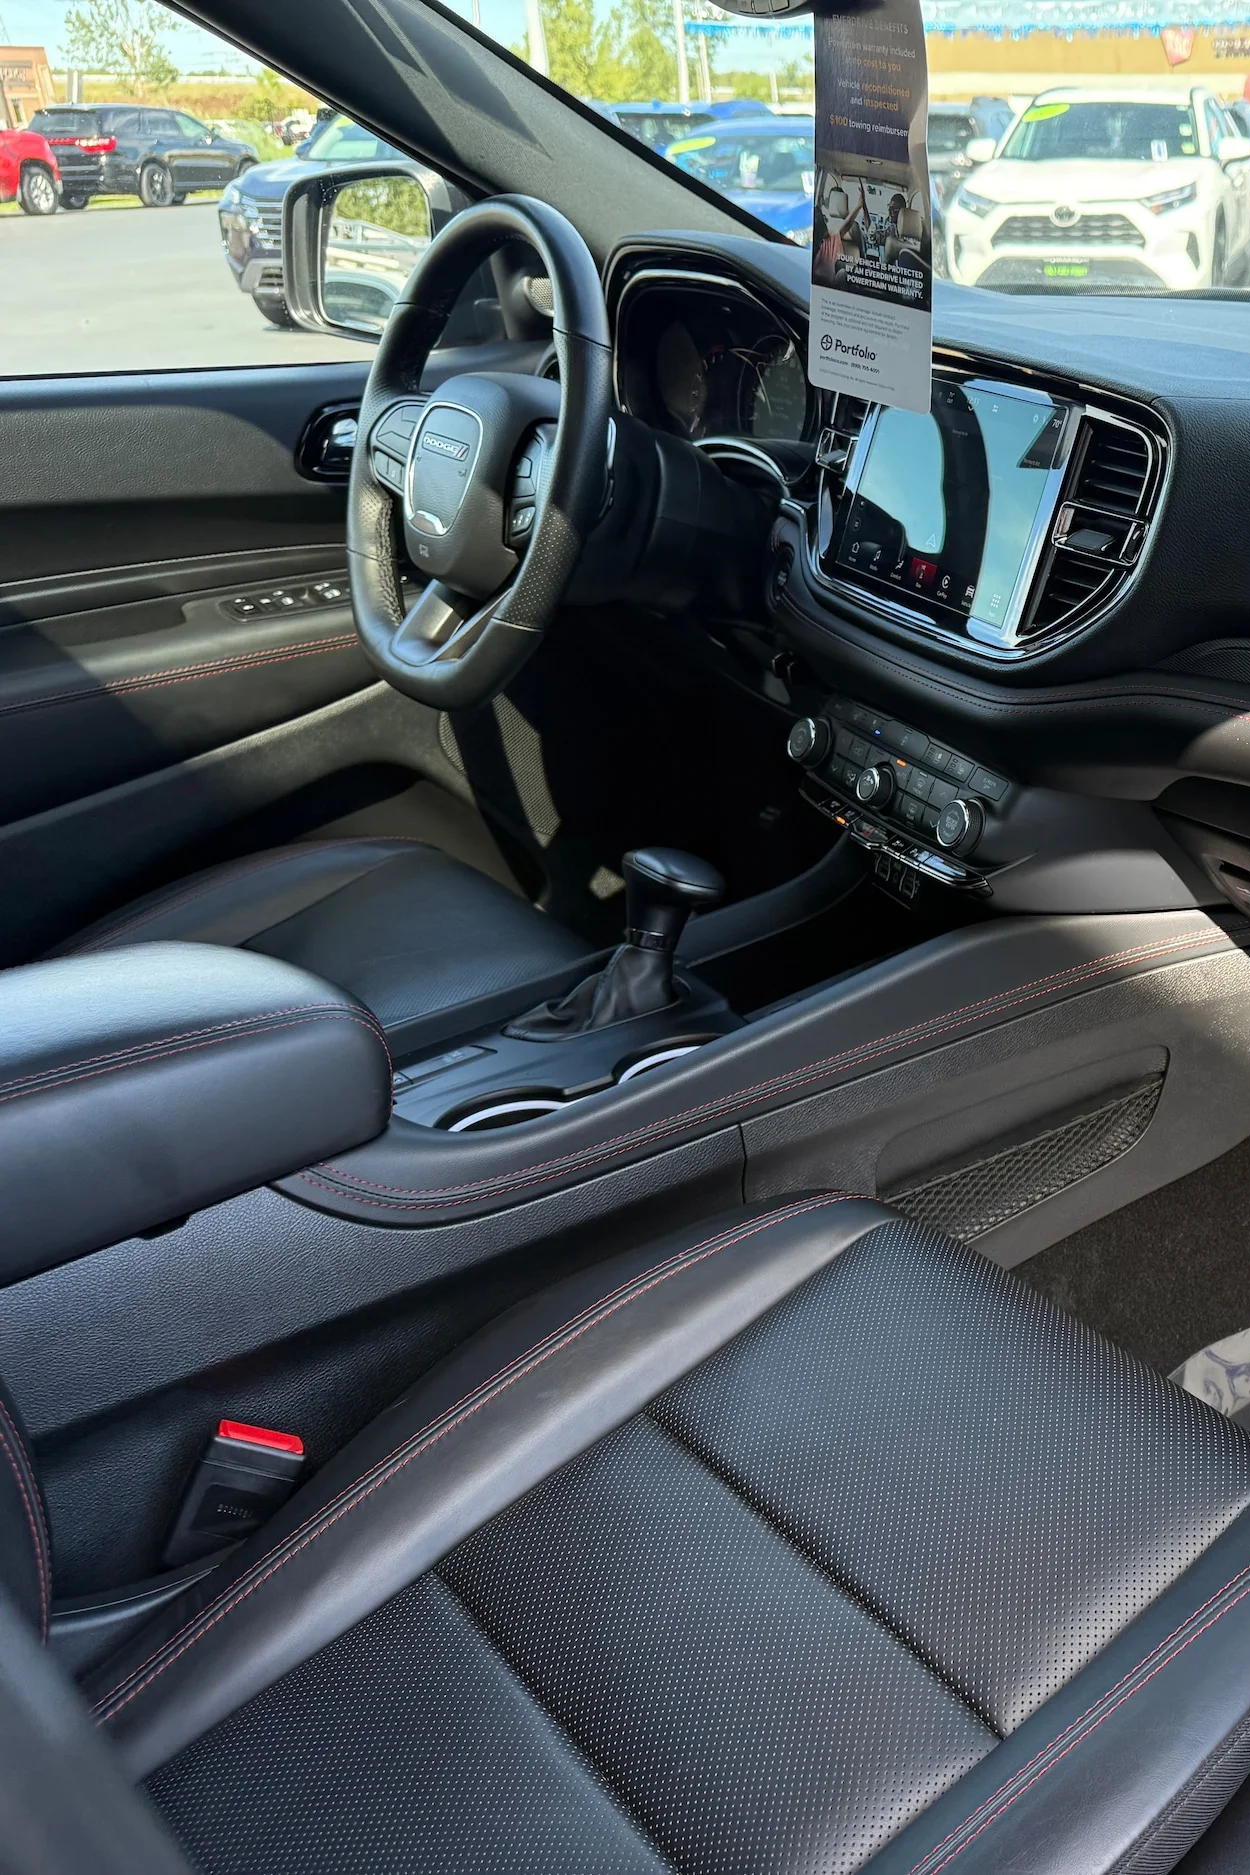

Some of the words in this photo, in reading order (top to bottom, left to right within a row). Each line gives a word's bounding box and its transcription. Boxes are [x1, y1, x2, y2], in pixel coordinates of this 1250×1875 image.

[889, 46, 916, 58] included
[863, 58, 878, 68] cost
[880, 60, 886, 69] to
[887, 62, 902, 73] you
[837, 77, 860, 90] Vehicle
[861, 81, 910, 97] reconditioned
[850, 96, 863, 106] and
[863, 97, 898, 112] inspected
[829, 113, 848, 127] $100
[849, 118, 871, 132] towing
[837, 253, 854, 263] YOUR
[854, 256, 880, 270] VEHICLE
[880, 263, 887, 271] IS
[887, 264, 924, 279] PROTECTED
[845, 264, 854, 273] BY
[854, 266, 864, 275] AN
[864, 268, 898, 284] EVERDRIVE
[899, 276, 924, 290] LIMITED
[846, 274, 887, 291] POWERTRAIN
[887, 283, 924, 299] WARRANTY.
[834, 338, 876, 361] Portfolio
[423, 435, 459, 454] DODGE
